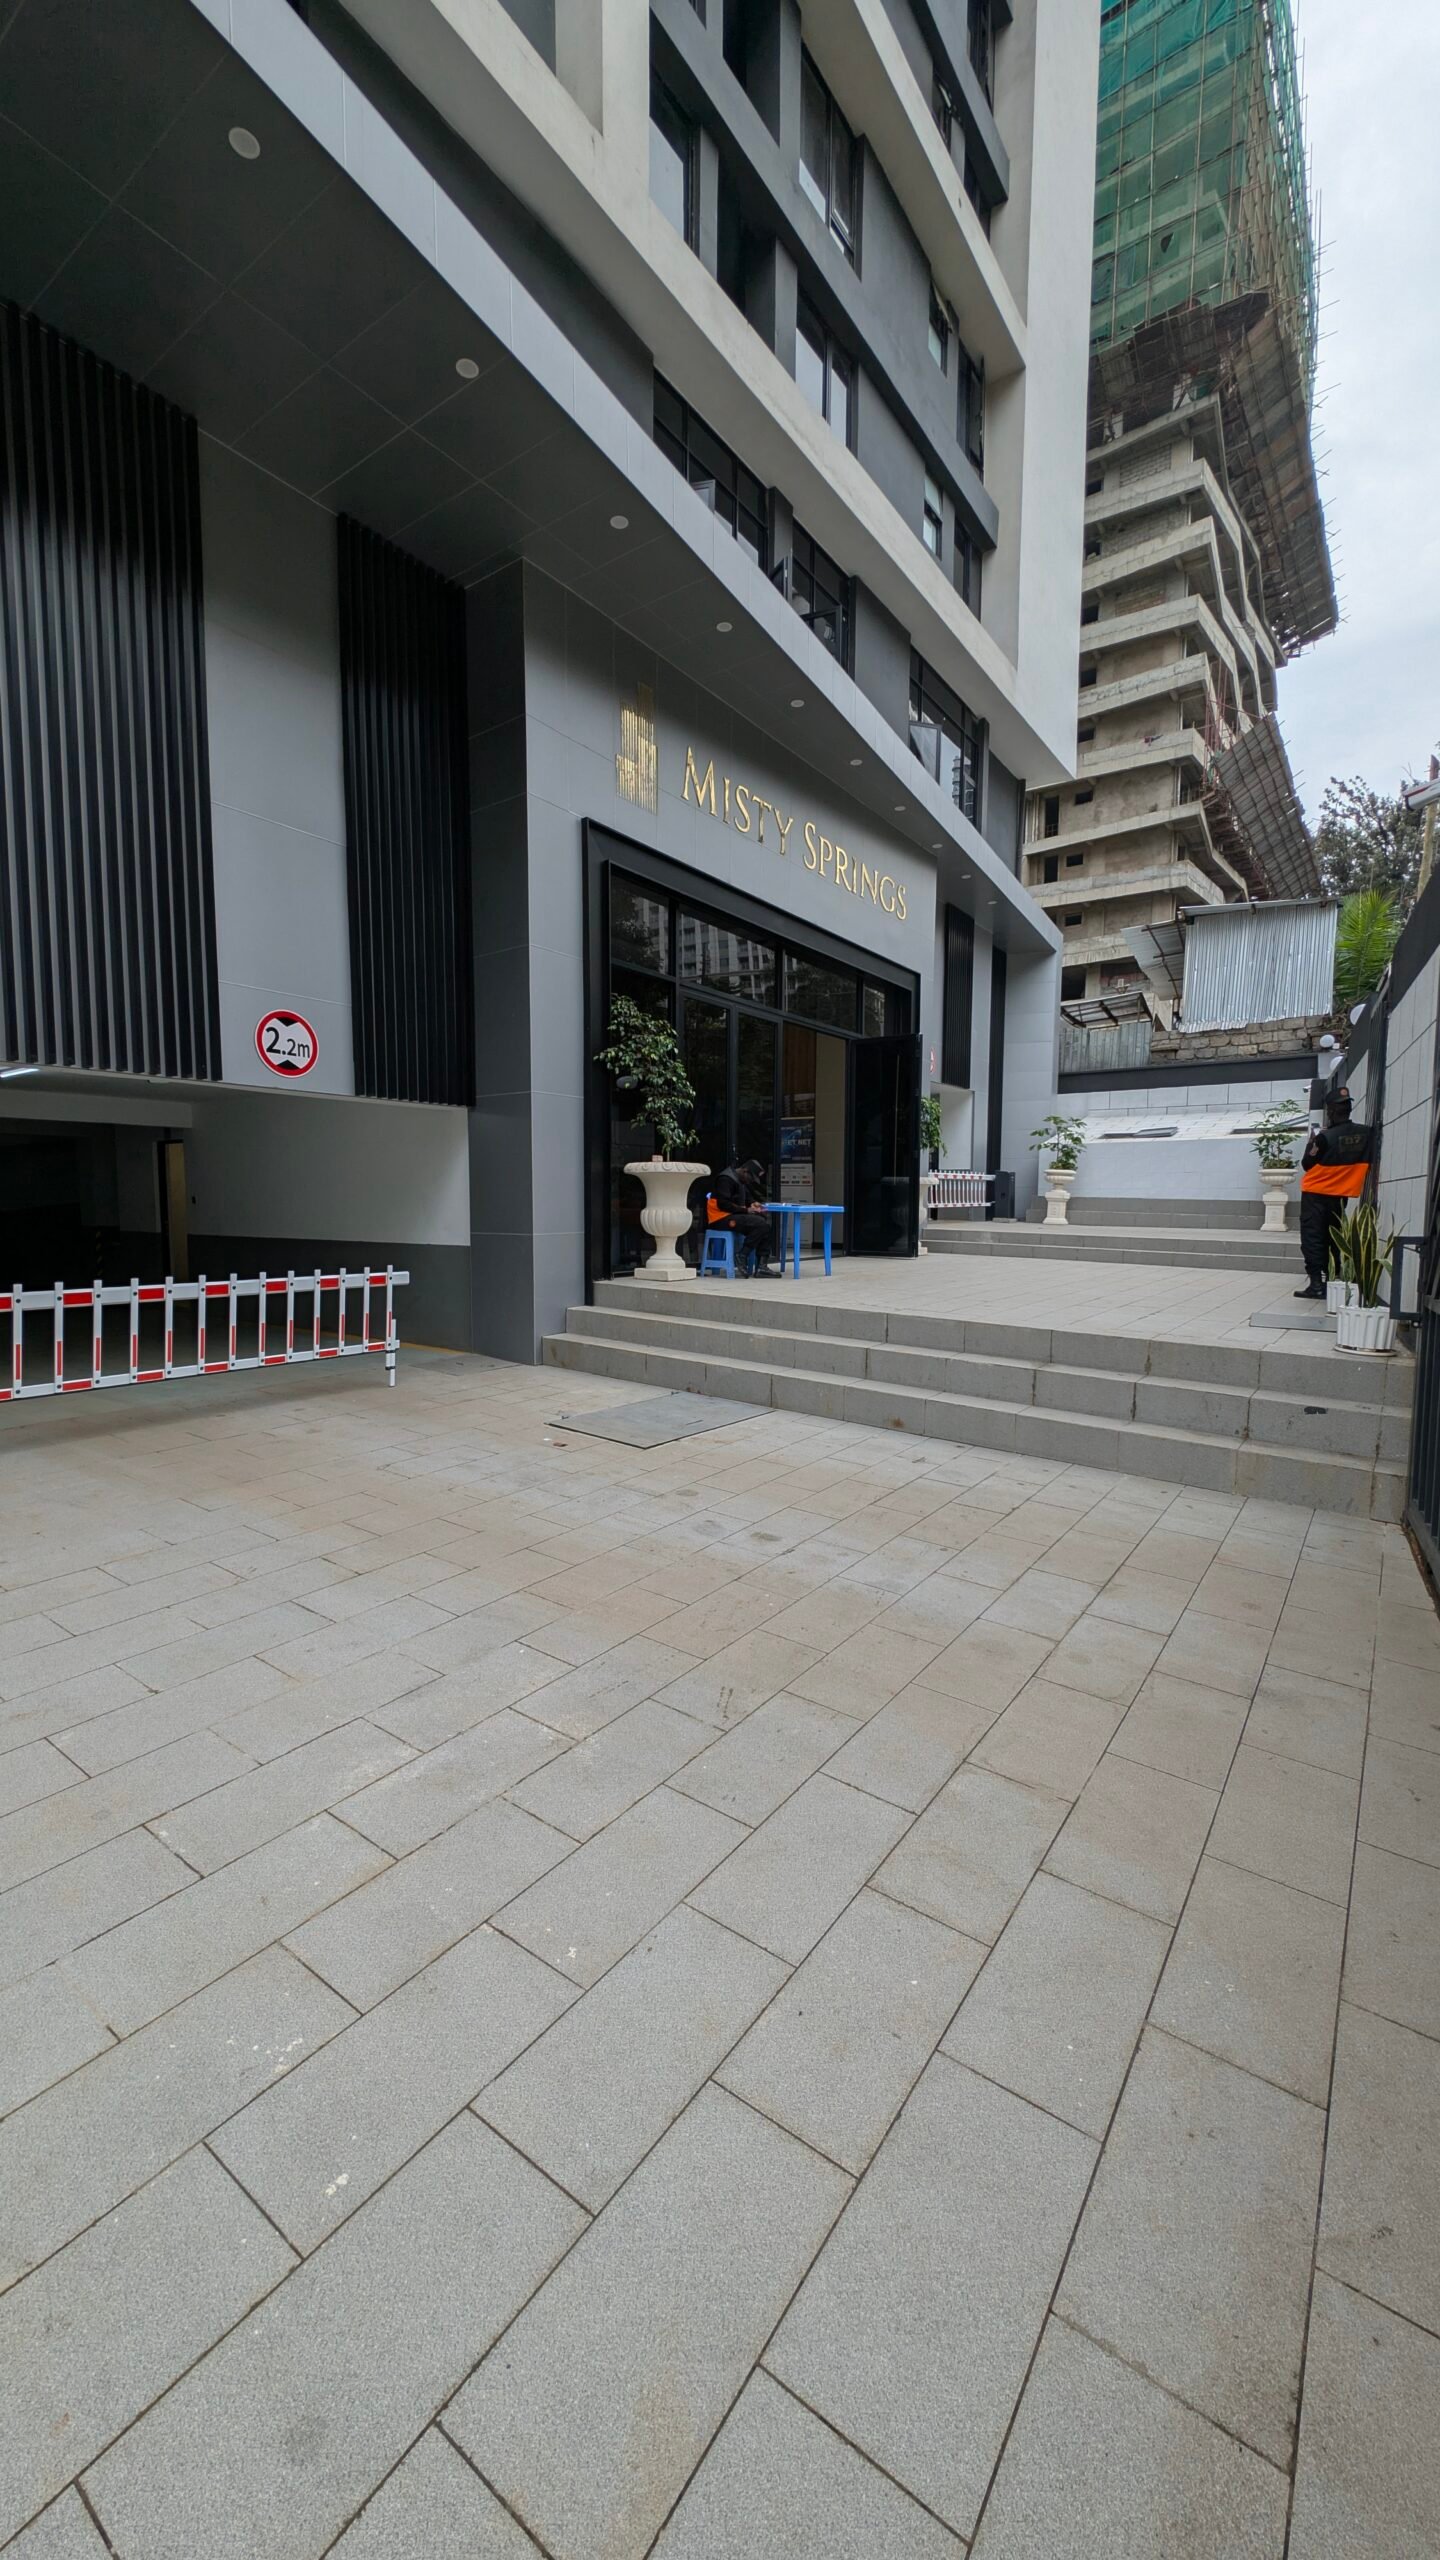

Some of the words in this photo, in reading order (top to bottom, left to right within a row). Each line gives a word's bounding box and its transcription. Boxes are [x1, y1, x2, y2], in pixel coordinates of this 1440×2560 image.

[681, 745, 794, 856] MISTY
[803, 821, 908, 921] SPRINGS
[265, 1026, 311, 1059] 2.2m
